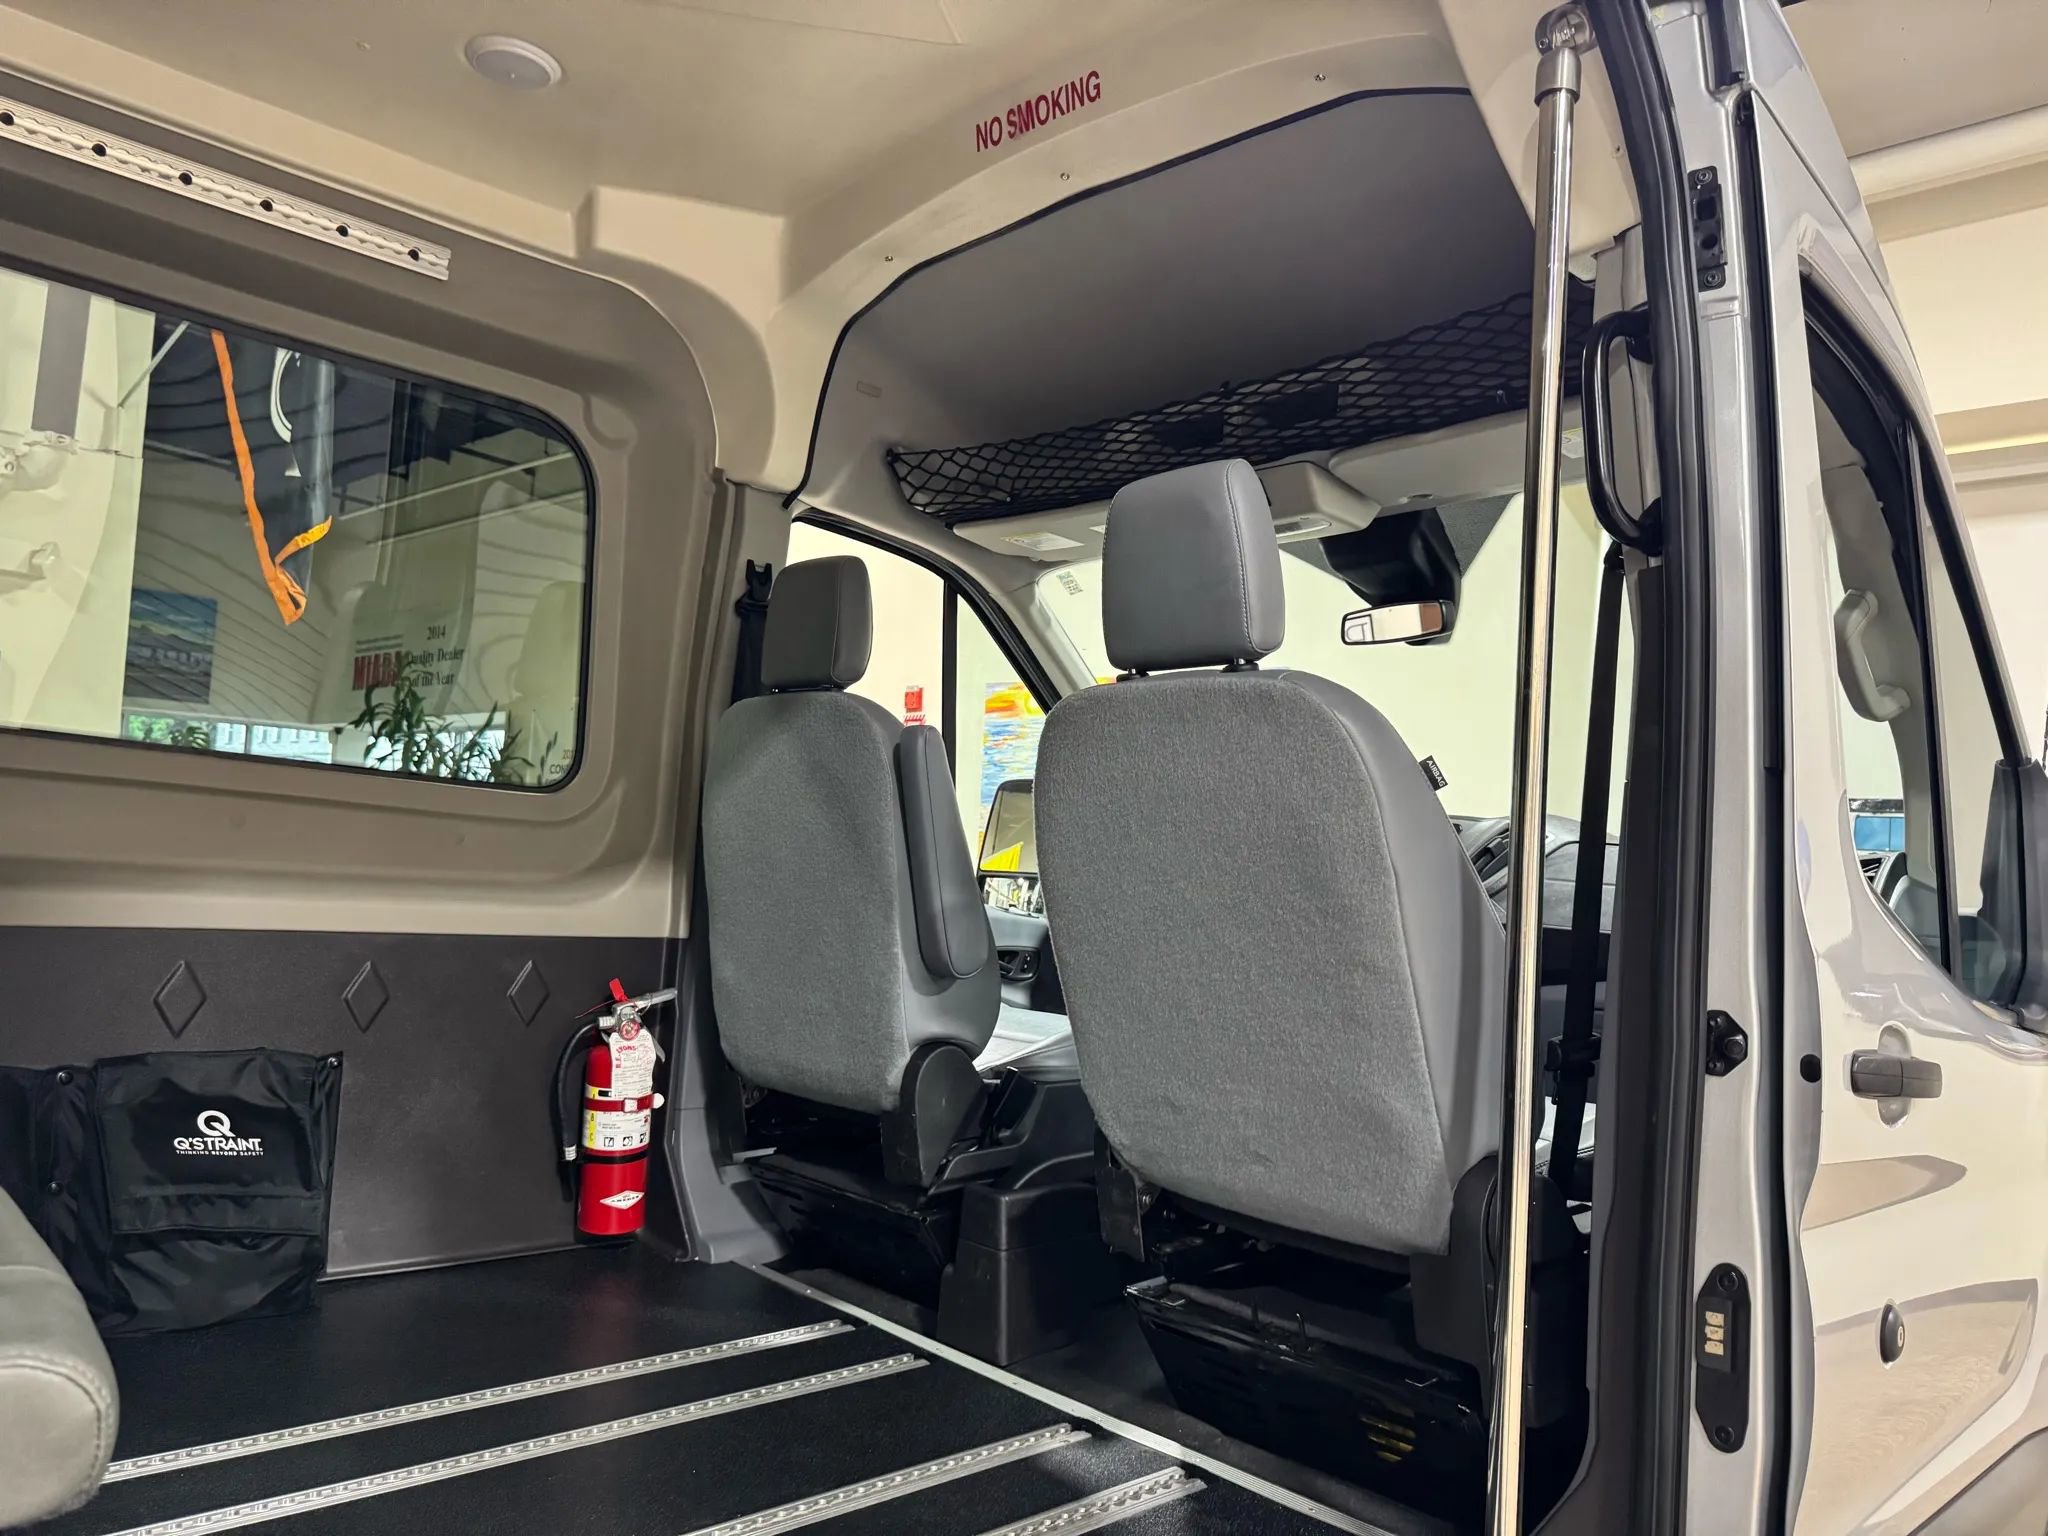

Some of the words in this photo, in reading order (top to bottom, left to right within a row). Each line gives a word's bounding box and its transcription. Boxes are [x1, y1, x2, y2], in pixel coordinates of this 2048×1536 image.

[976, 116, 1003, 152] NO
[1006, 70, 1101, 139] SMOKING
[427, 624, 446, 640] 2014
[438, 647, 464, 662] Dealer
[1426, 760, 1446, 787] AIRBAG
